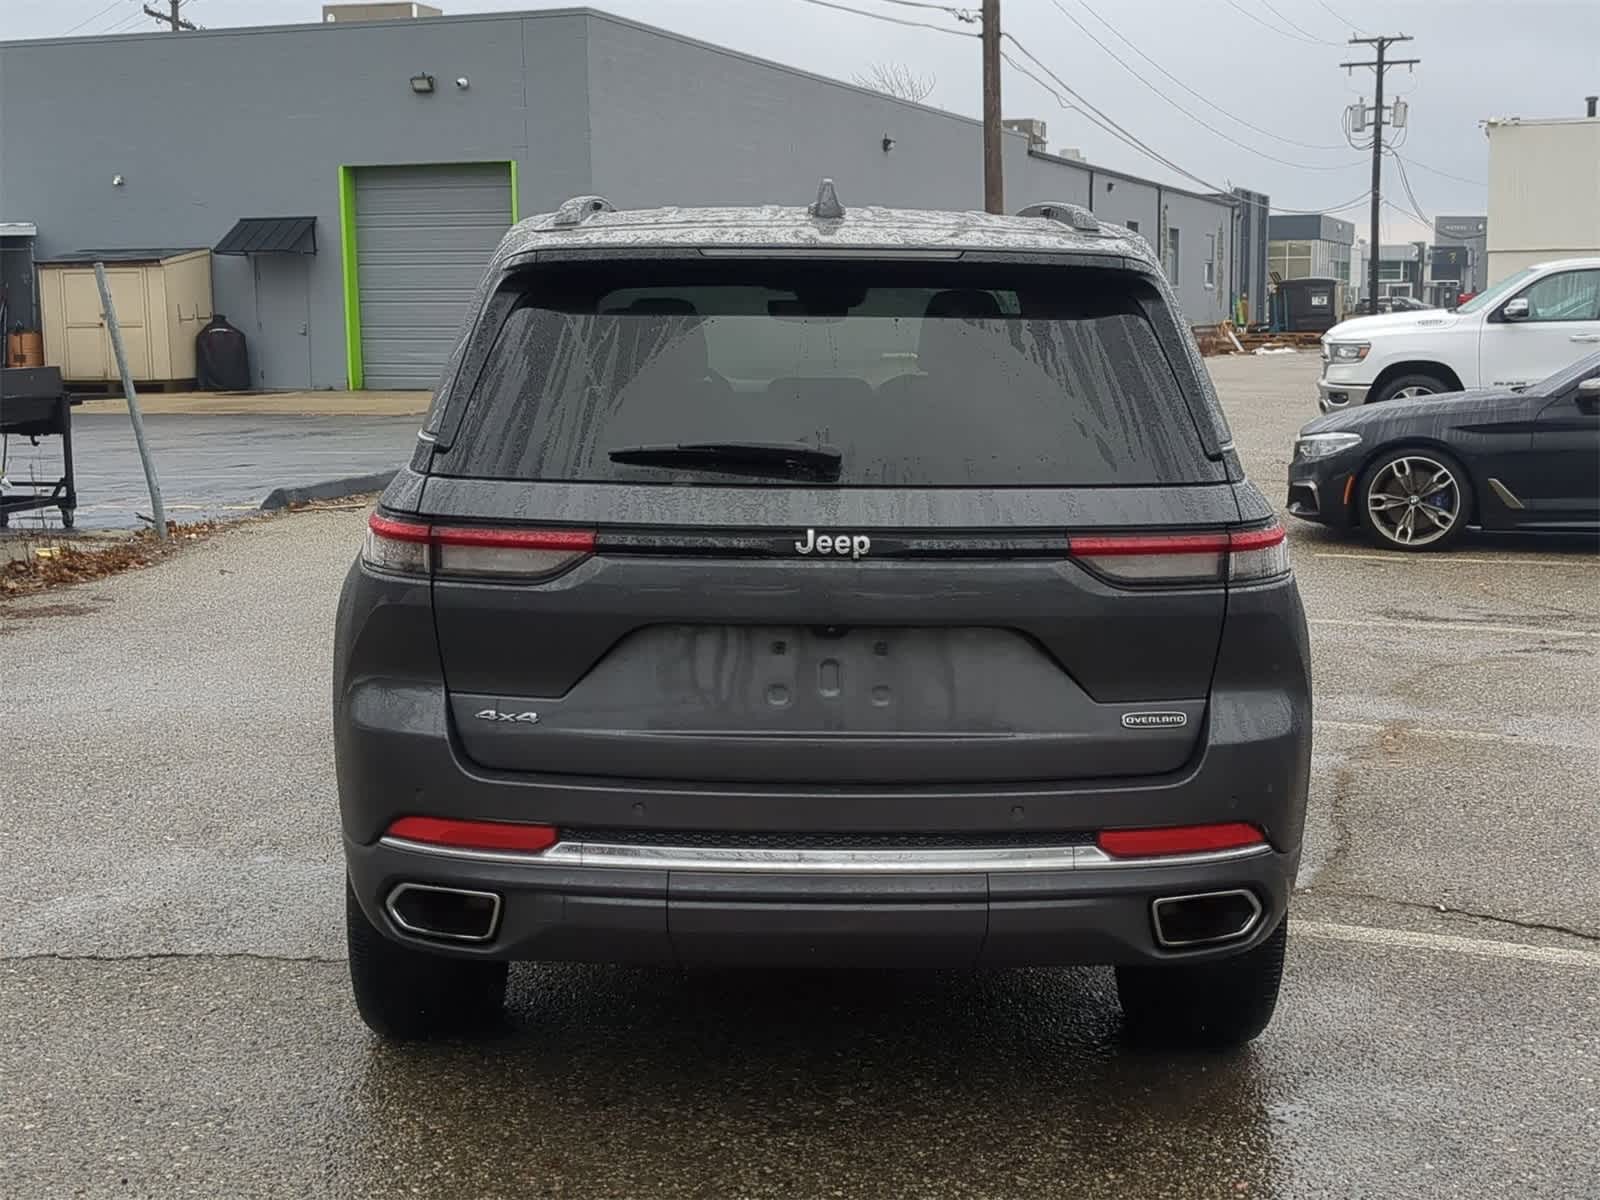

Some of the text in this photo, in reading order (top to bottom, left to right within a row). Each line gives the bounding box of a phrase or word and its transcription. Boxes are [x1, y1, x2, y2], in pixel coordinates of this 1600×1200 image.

[795, 528, 871, 560] Jeep
[474, 709, 539, 724] 4x4
[1125, 715, 1184, 725] OVERLAND
